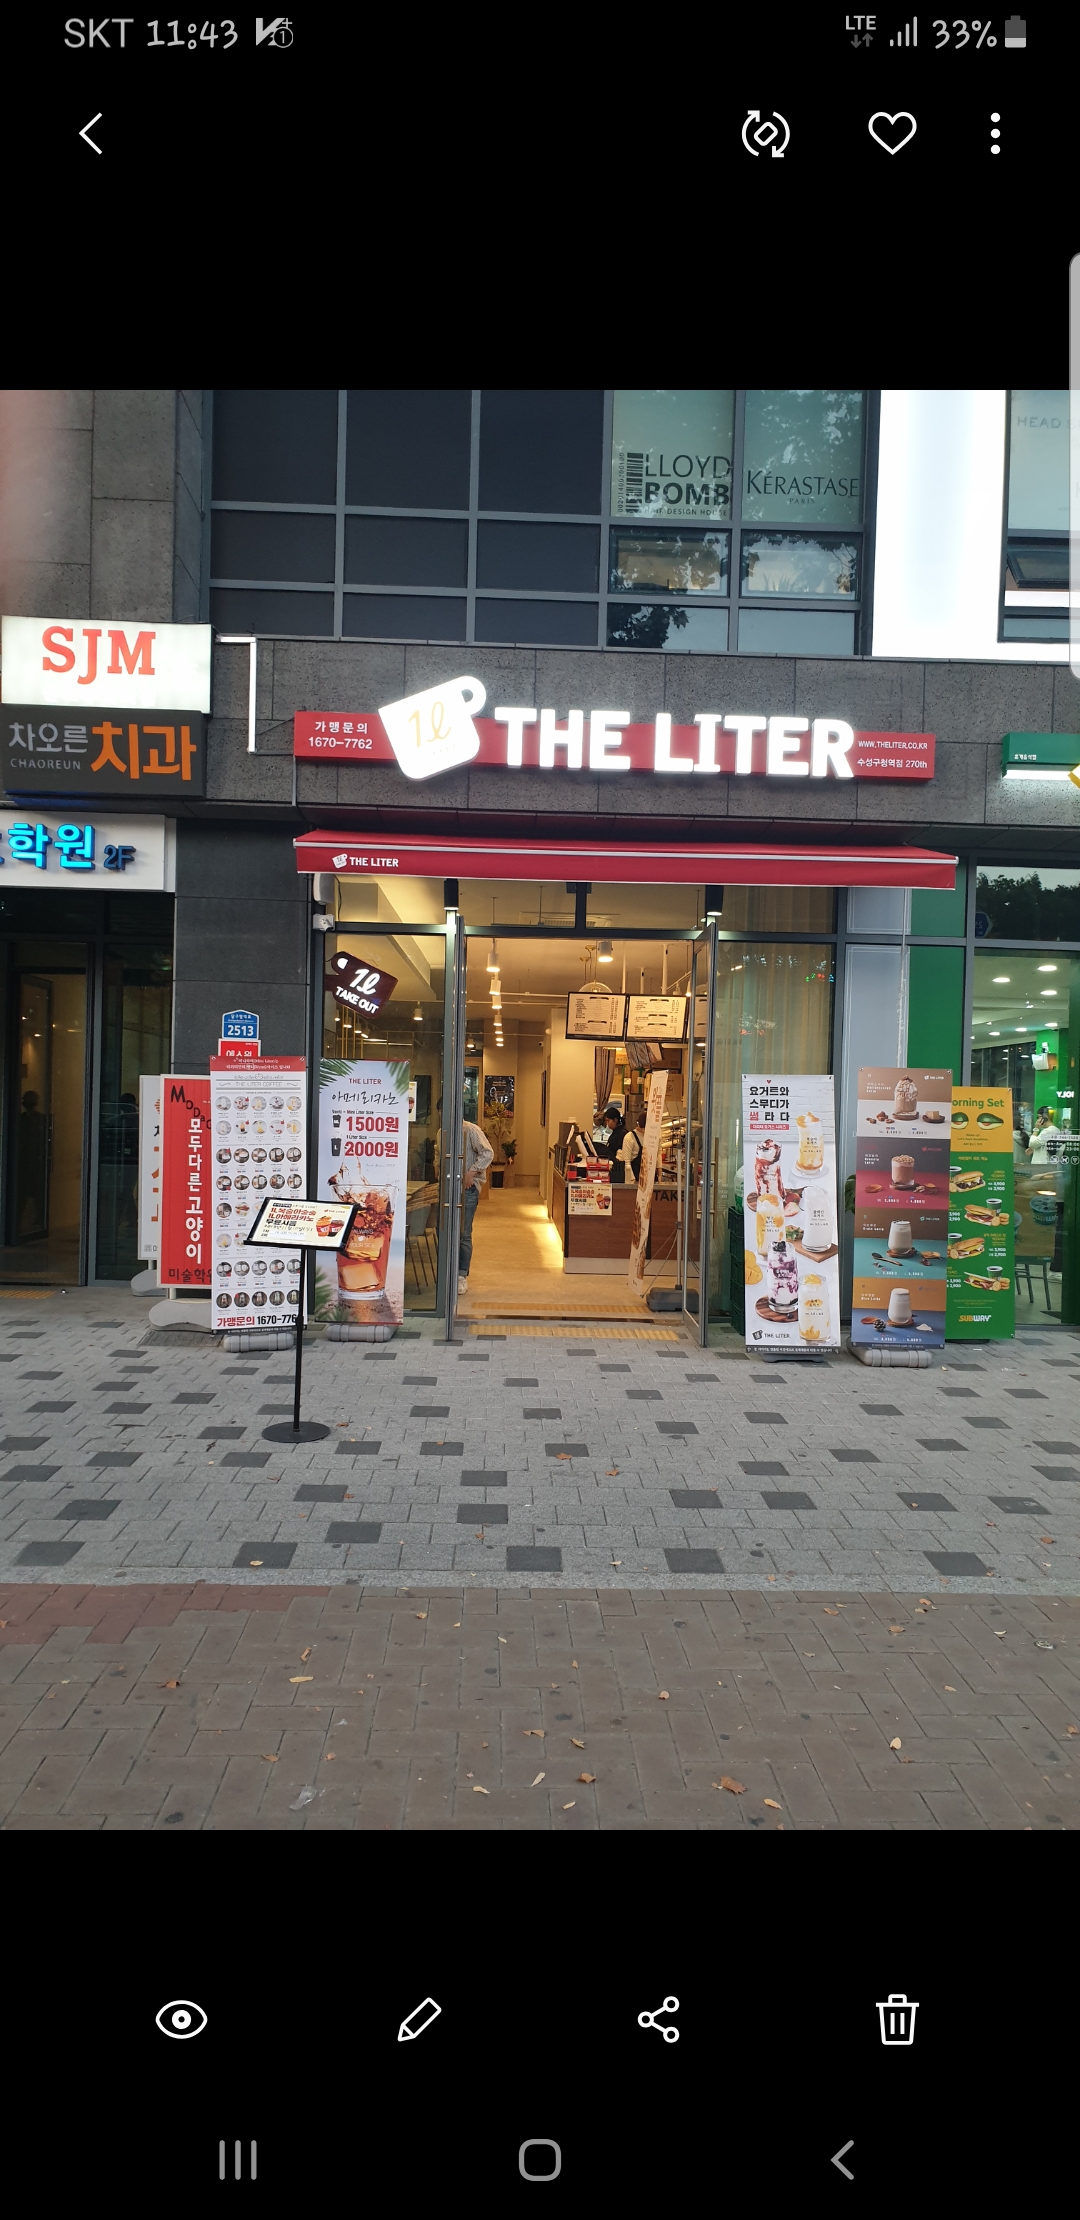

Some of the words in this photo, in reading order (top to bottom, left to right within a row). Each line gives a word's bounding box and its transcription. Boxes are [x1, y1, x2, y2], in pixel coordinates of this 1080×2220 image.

[1017, 416, 1061, 429] HEAD
[645, 453, 731, 479] LLOYD
[645, 482, 730, 506] BOMB
[701, 509, 727, 517] HOUSE
[42, 626, 156, 684] SJM
[309, 736, 373, 749] 1670-7762
[494, 707, 631, 771] THE
[654, 712, 854, 779] LITER
[858, 740, 928, 750] WWW.THELITER.CO.KR
[8, 723, 89, 753] 차오른
[90, 721, 197, 780] 치과
[10, 758, 81, 770] CHAOREUN
[857, 758, 903, 768] 수성구청역점
[905, 759, 928, 768] 270th
[0, 823, 96, 870] 학원
[103, 844, 136, 871] 2F
[349, 857, 368, 866] THE
[371, 857, 399, 867] LITER
[335, 986, 360, 1005] TAKE
[359, 999, 379, 1014] OUT
[227, 1025, 254, 1036] 2513
[750, 1086, 789, 1096] 요거트와
[332, 1091, 399, 1105] 아메리카노
[750, 1099, 789, 1109] 스무디가
[952, 1098, 984, 1109] orning
[987, 1098, 1005, 1107] Set
[346, 1116, 399, 1132] 1500원
[344, 1141, 399, 1157] 2000원
[217, 1316, 255, 1327] 가맹문의
[257, 1314, 298, 1325] 1670-776
